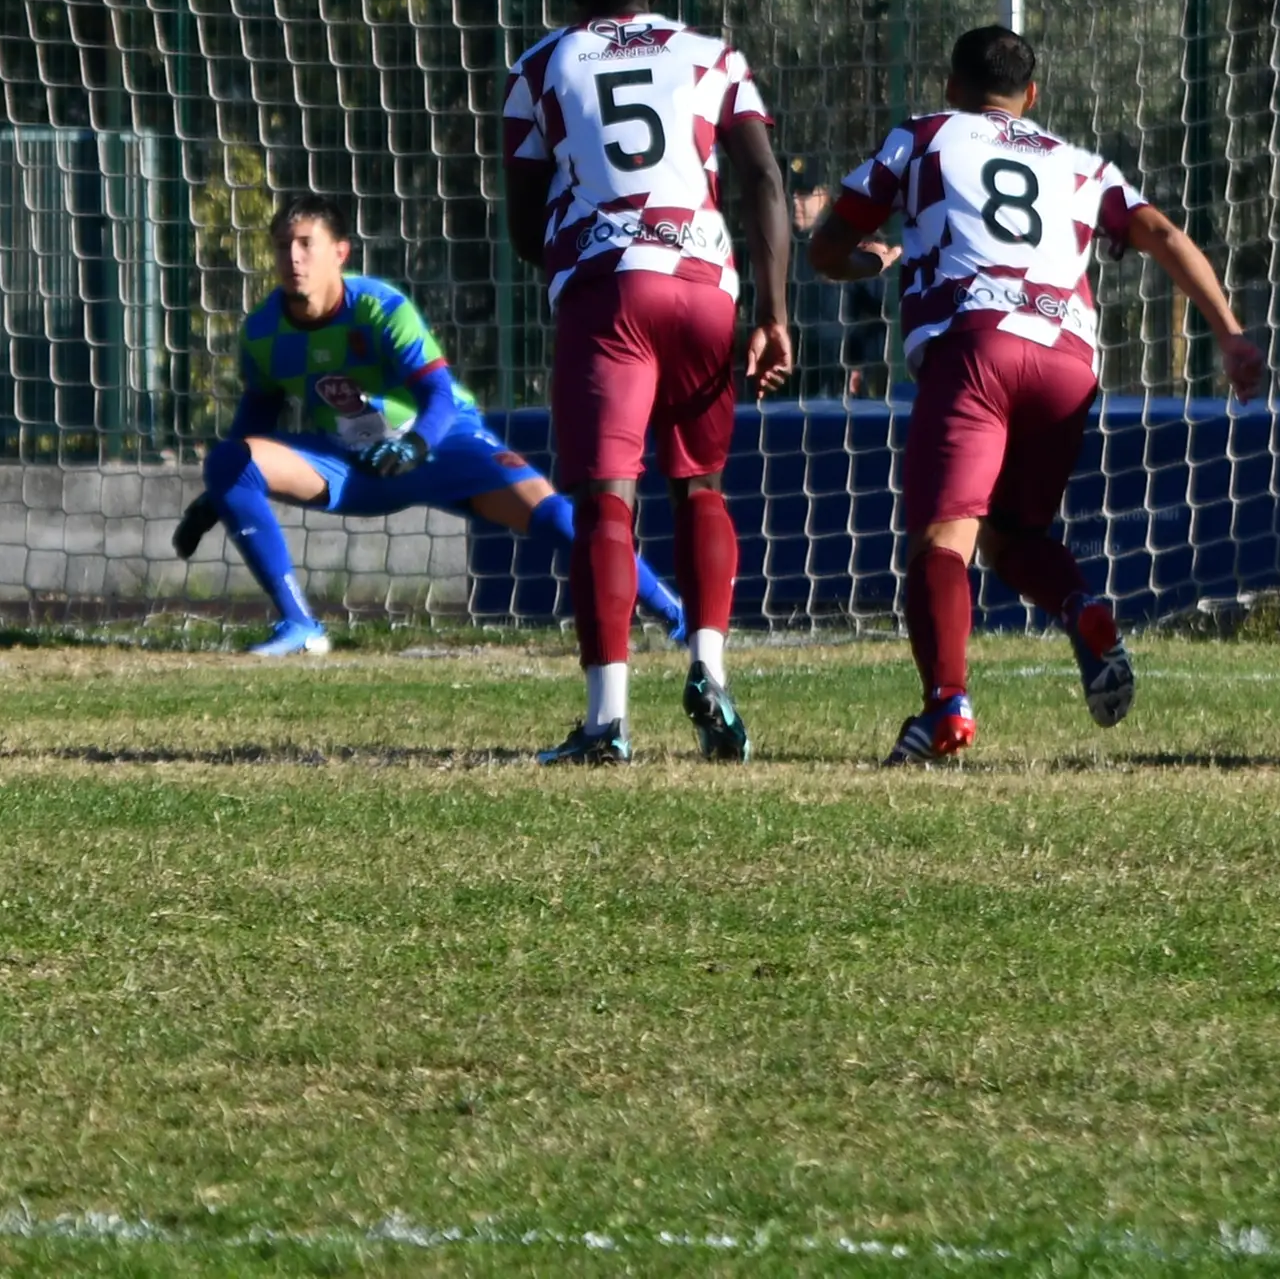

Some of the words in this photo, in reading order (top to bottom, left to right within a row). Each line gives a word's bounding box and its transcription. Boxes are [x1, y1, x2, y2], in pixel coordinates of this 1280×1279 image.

[578, 45, 671, 62] ROMANERIA
[594, 68, 666, 172] 5
[981, 157, 1043, 249] 8
